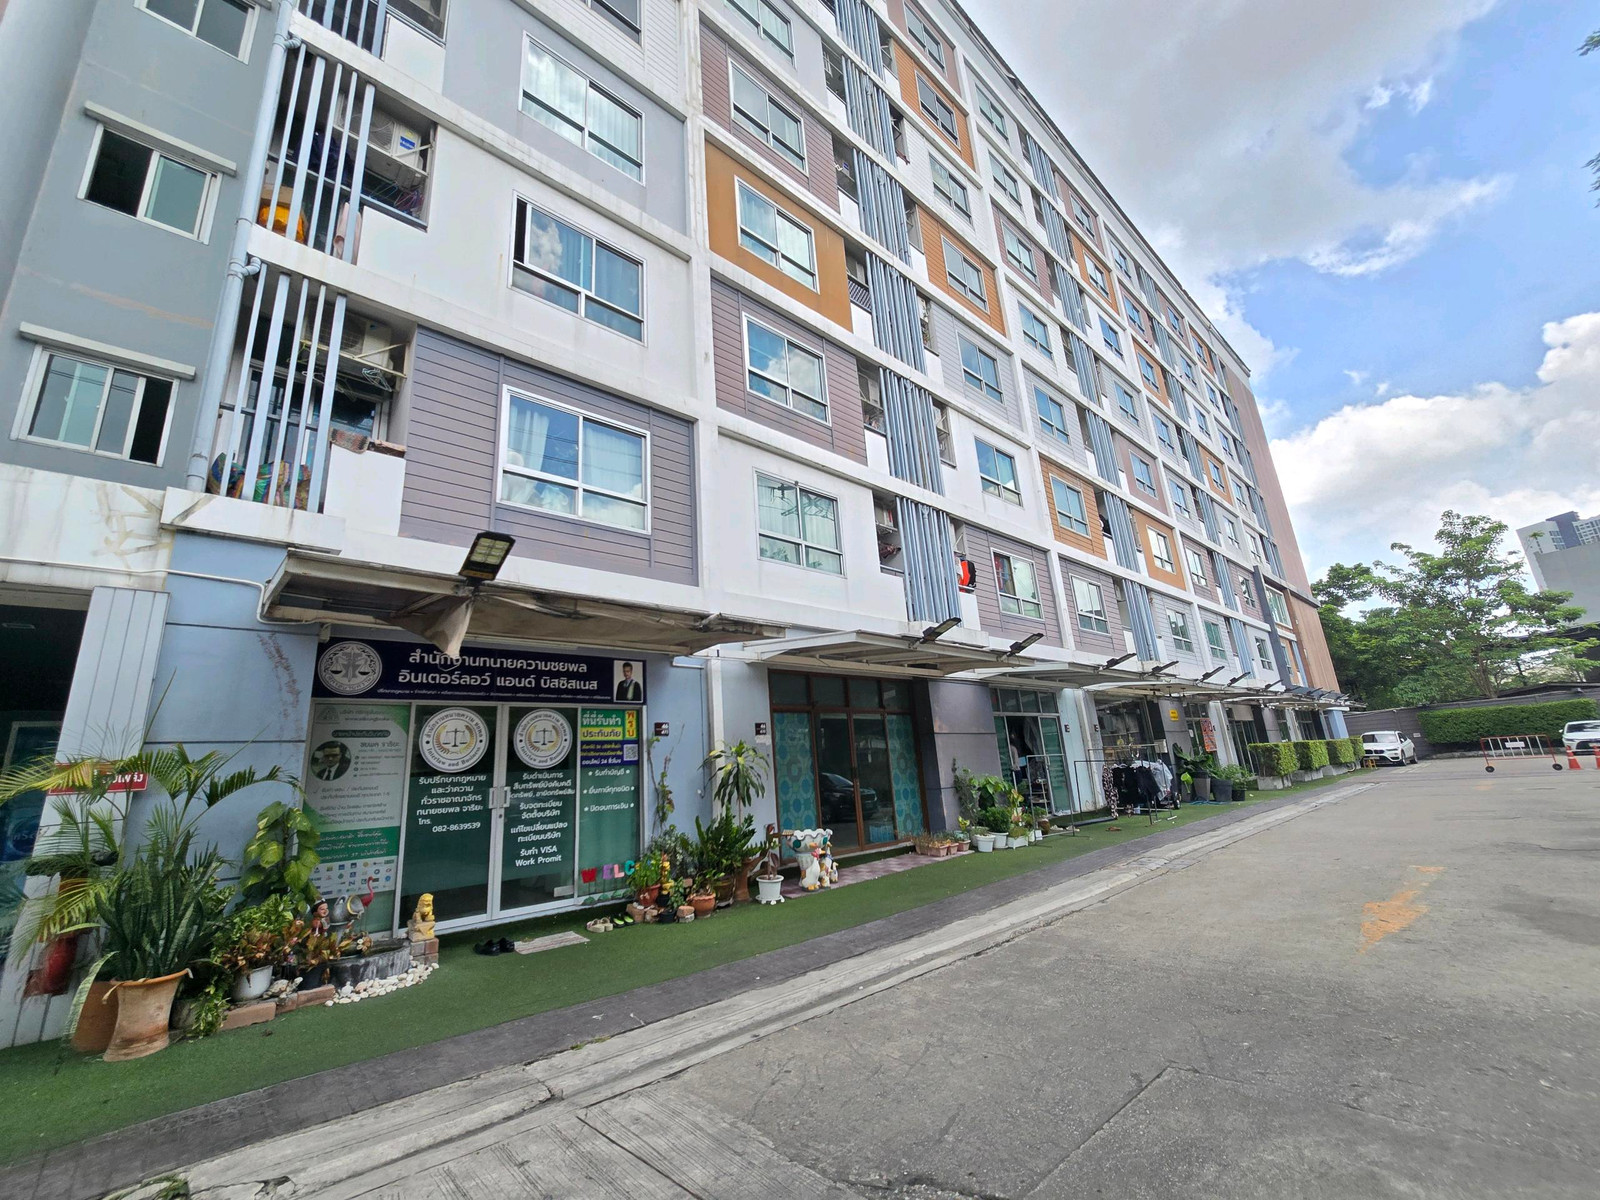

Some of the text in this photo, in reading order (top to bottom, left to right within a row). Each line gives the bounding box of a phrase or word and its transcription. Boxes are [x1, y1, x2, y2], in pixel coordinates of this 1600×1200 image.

[409, 648, 587, 673] สำนักงานทนายความชยพล
[398, 669, 598, 691] อินเตอร์ลอว์ แอนด์ บิสซิสเนส
[582, 710, 621, 726] ที่นี่รับทำ
[582, 728, 621, 738] ประกันภัย
[418, 775, 487, 785] รับปรึกษากฎหมาย
[431, 785, 474, 794] และว่าความ
[420, 794, 482, 805] ทั่วราชอาณาจักร
[519, 799, 563, 810] รับจดทะเบียน
[416, 804, 484, 816] ทนายชยพล จาริยะ
[521, 808, 561, 820] จัดตั้งบริษัท
[432, 821, 481, 833] 082-8639539
[517, 831, 561, 843] ทะเบียนบริษัท
[519, 845, 558, 857] รับทำ VISA
[515, 854, 562, 867] Work Promit
